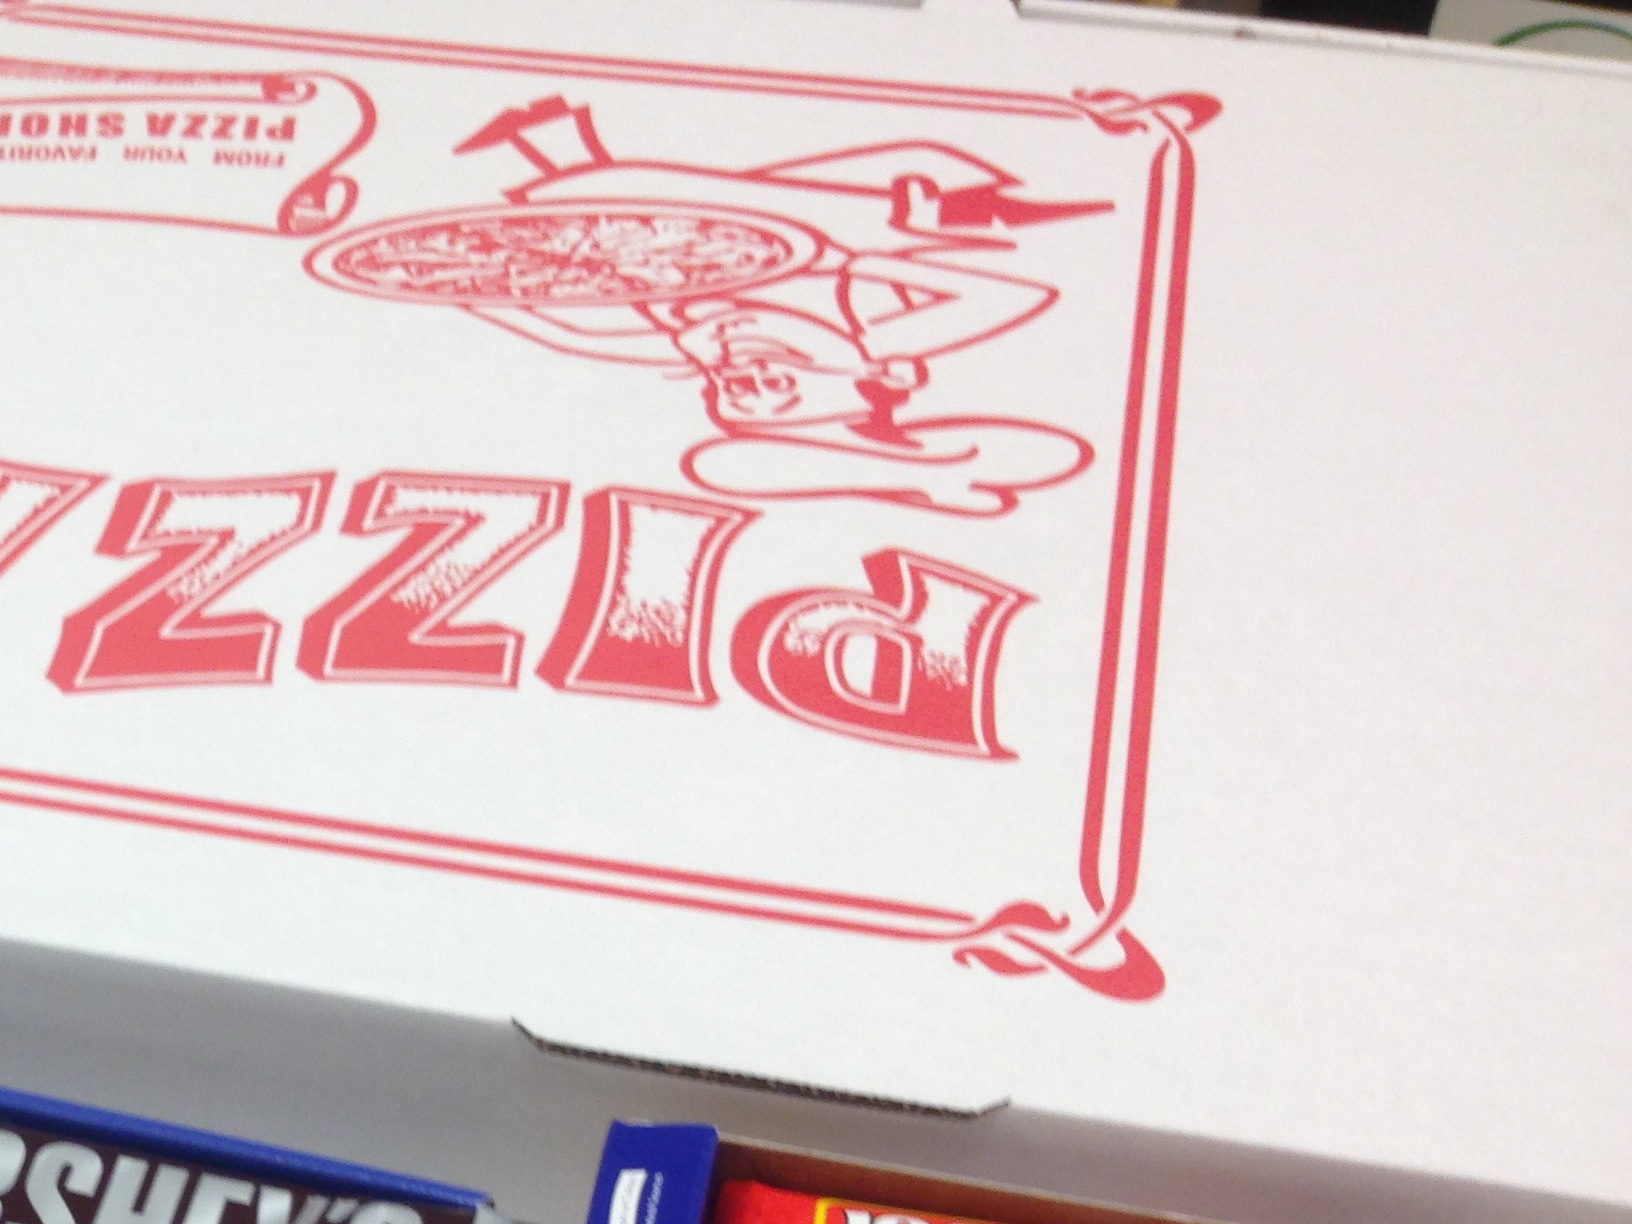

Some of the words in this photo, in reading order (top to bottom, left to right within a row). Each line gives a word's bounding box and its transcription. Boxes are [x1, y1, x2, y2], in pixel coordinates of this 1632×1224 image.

[145, 111, 297, 143] PIZZA
[122, 146, 187, 164] YOUR
[212, 149, 286, 169] FROM
